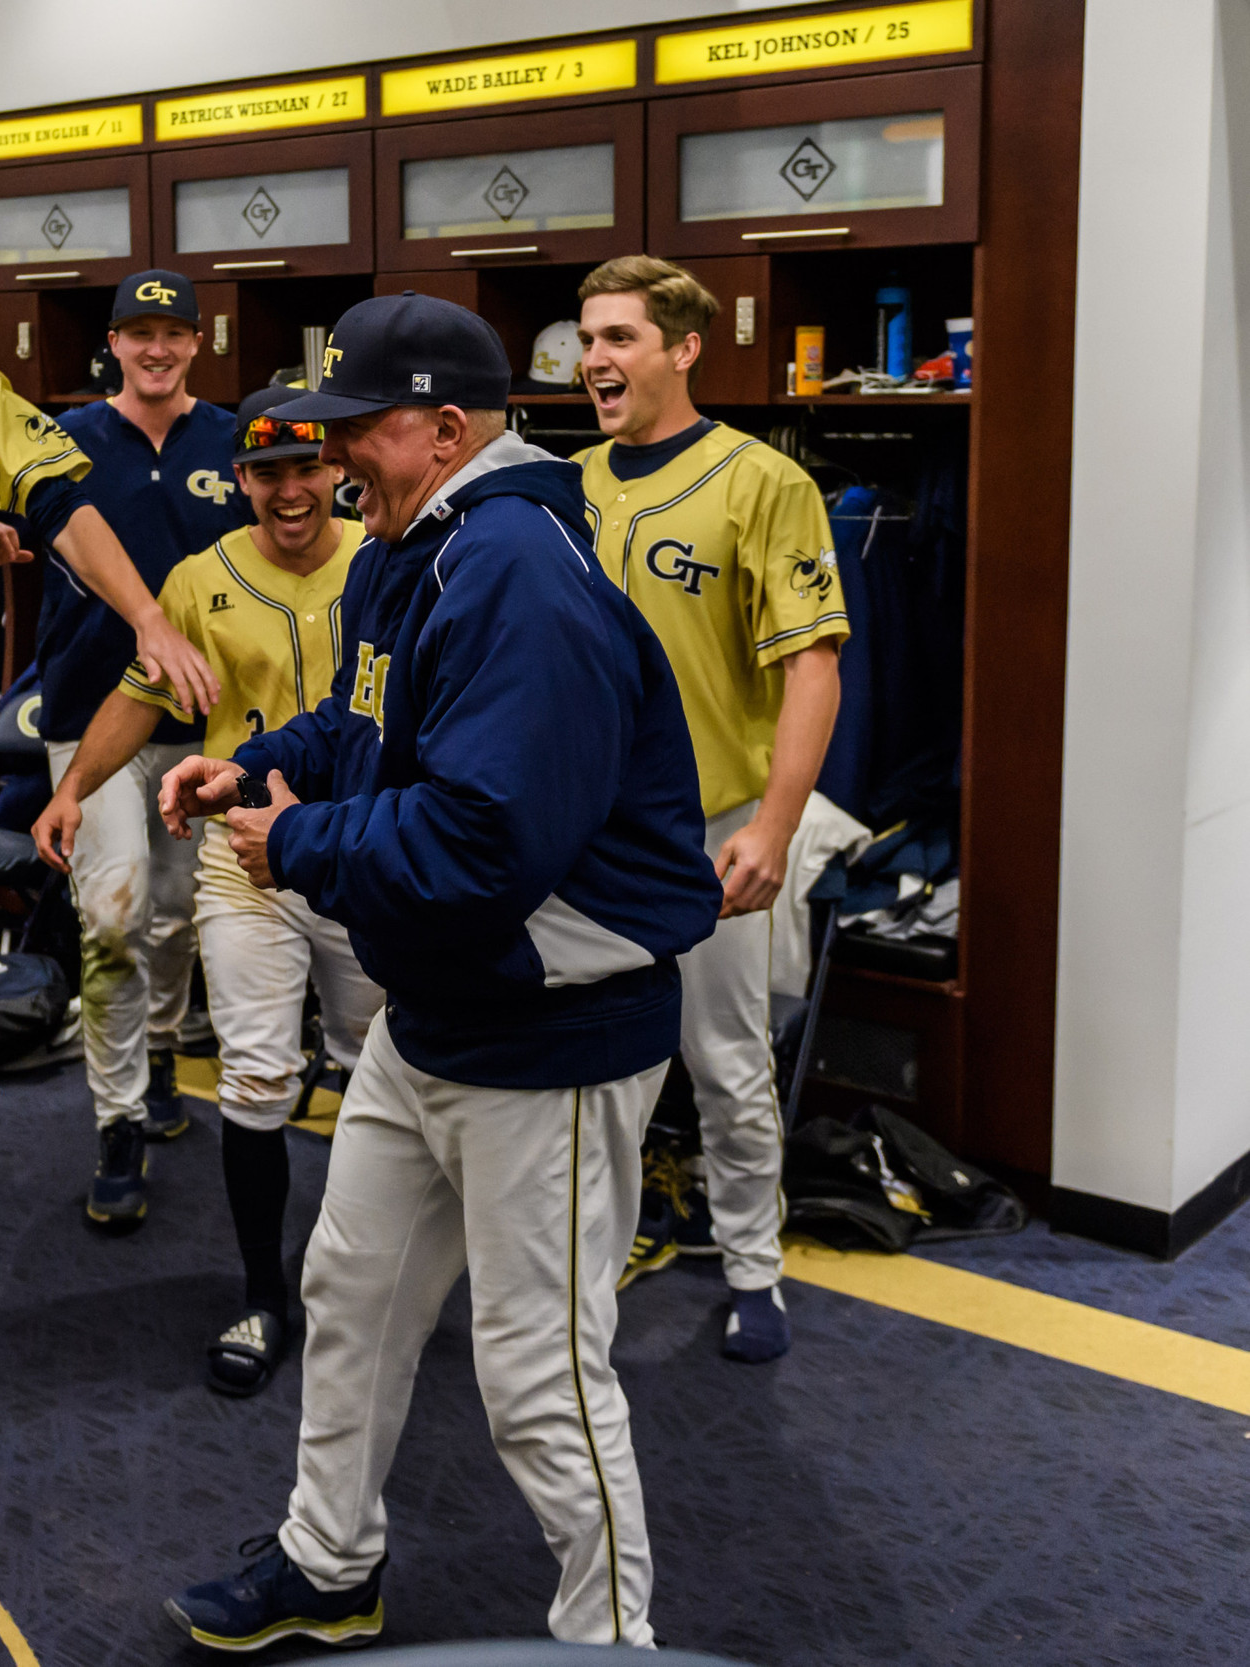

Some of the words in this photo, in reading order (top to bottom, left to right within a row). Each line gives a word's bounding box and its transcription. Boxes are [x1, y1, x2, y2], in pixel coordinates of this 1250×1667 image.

[707, 43, 749, 62] KEL
[754, 27, 859, 61] JOHNSON
[886, 21, 911, 41] 25
[426, 75, 478, 95] WADE
[483, 66, 548, 89] BAILEY
[573, 61, 584, 78] 3
[170, 105, 235, 126] PATRICK
[237, 95, 310, 117] WISEMAN
[332, 91, 349, 107] 27
[35, 124, 90, 142] ENGLISH
[111, 120, 123, 134] 11
[135, 280, 178, 305] GT
[533, 351, 561, 375] GT
[186, 469, 236, 506] GT
[645, 538, 720, 597] GT
